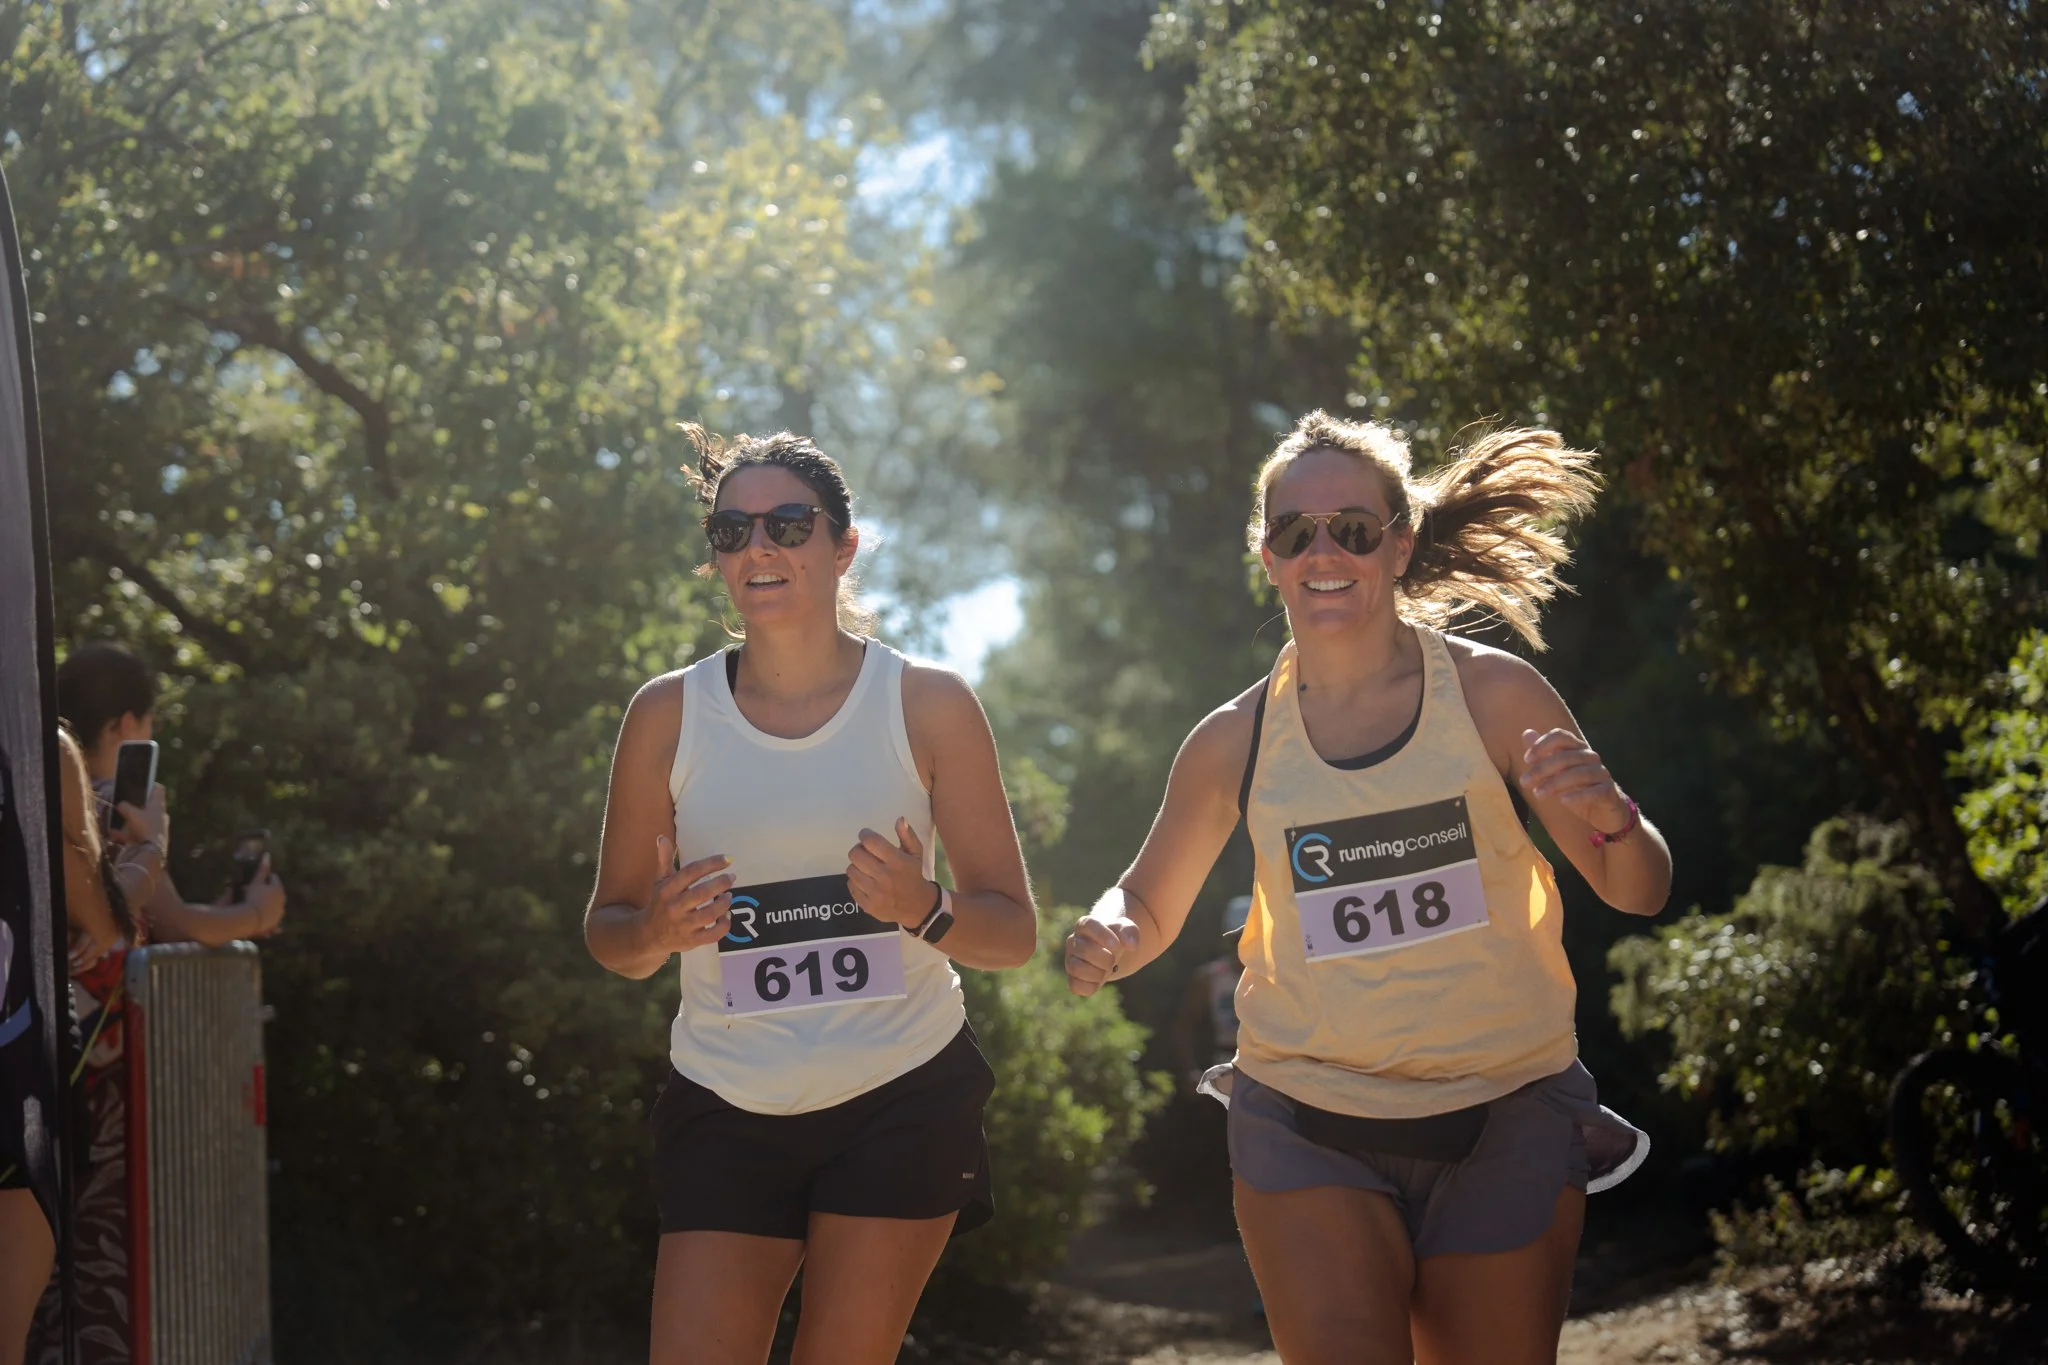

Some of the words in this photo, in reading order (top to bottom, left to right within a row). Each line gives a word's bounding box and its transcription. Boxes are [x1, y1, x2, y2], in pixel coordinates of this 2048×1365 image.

[1339, 822, 1467, 863] runningconseil
[1333, 881, 1451, 943] 618
[754, 947, 870, 1002] 619
